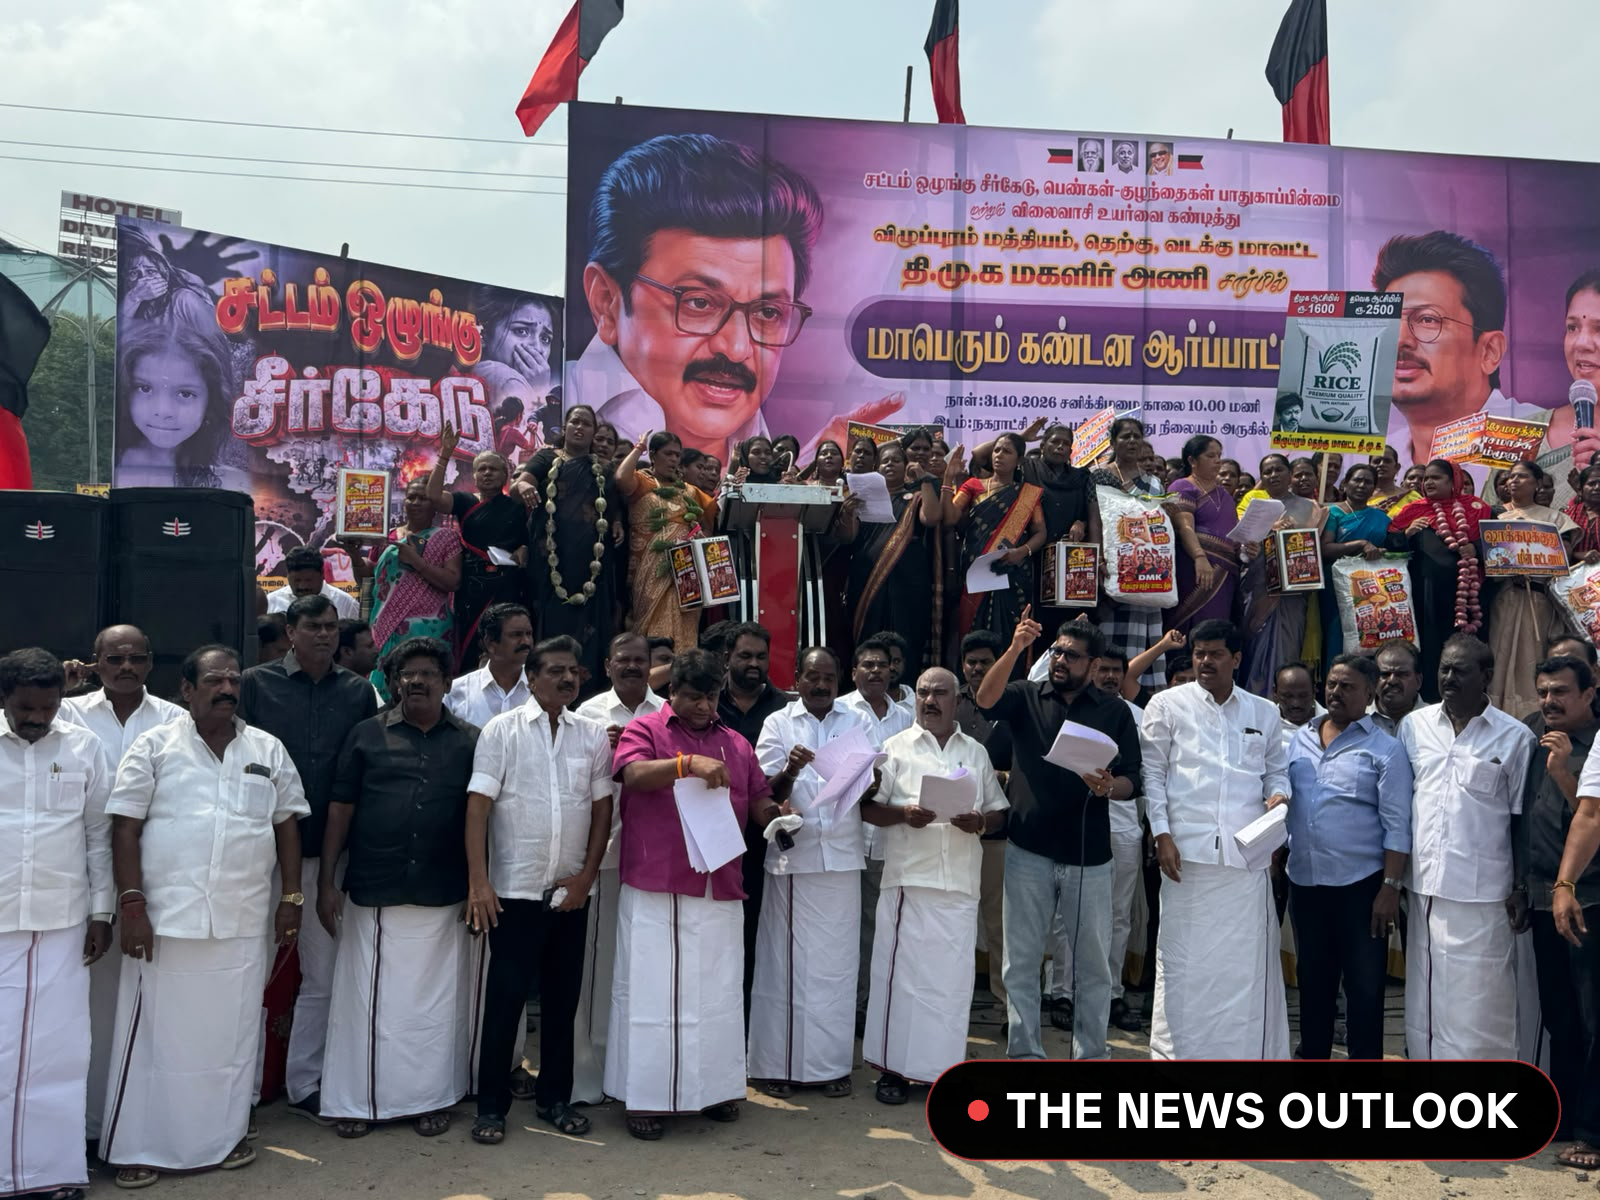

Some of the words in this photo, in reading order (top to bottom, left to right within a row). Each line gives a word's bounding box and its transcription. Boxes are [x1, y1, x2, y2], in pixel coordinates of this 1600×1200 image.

[864, 171, 912, 189] சட்டம்
[916, 173, 976, 195] ஒழுங்கு
[980, 175, 1040, 197] சீர்கேடு,
[1219, 186, 1341, 208] பாதுகாப்பின்மை
[73, 194, 171, 224] HOTEL
[1012, 201, 1094, 220] விலைவாசி
[1097, 204, 1164, 223] உயர்வை
[1168, 206, 1241, 230] கண்டித்து
[873, 222, 979, 249] விழுப்புரம்
[983, 227, 1079, 252] மத்தியம்,
[1084, 231, 1159, 257] தெற்கு,
[1165, 233, 1234, 257] வடக்கு
[1238, 240, 1319, 259] மாவட்ட
[902, 255, 1005, 290] தி.மு.க
[1010, 260, 1116, 289] மகளிர்
[1122, 263, 1210, 291] அணி
[1217, 268, 1290, 299] சார்பில்
[216, 266, 342, 335] சட்டம்
[346, 279, 483, 367] ஒழுங்கு
[867, 314, 1010, 373] மாபெரும்
[1018, 315, 1135, 367] கண்டன
[1143, 318, 1284, 376] ஆர்ப்பாட்
[1308, 390, 1337, 399] PREMIUM
[1338, 391, 1363, 399] QUALITY
[1313, 375, 1361, 391] RICE
[231, 354, 497, 458] சீர்கேடு
[1143, 400, 1186, 413] காலை
[1189, 399, 1226, 413] 10.00
[1229, 399, 1260, 414] மணி
[1159, 420, 1217, 437] நிலையம்
[1379, 629, 1404, 640] DMK
